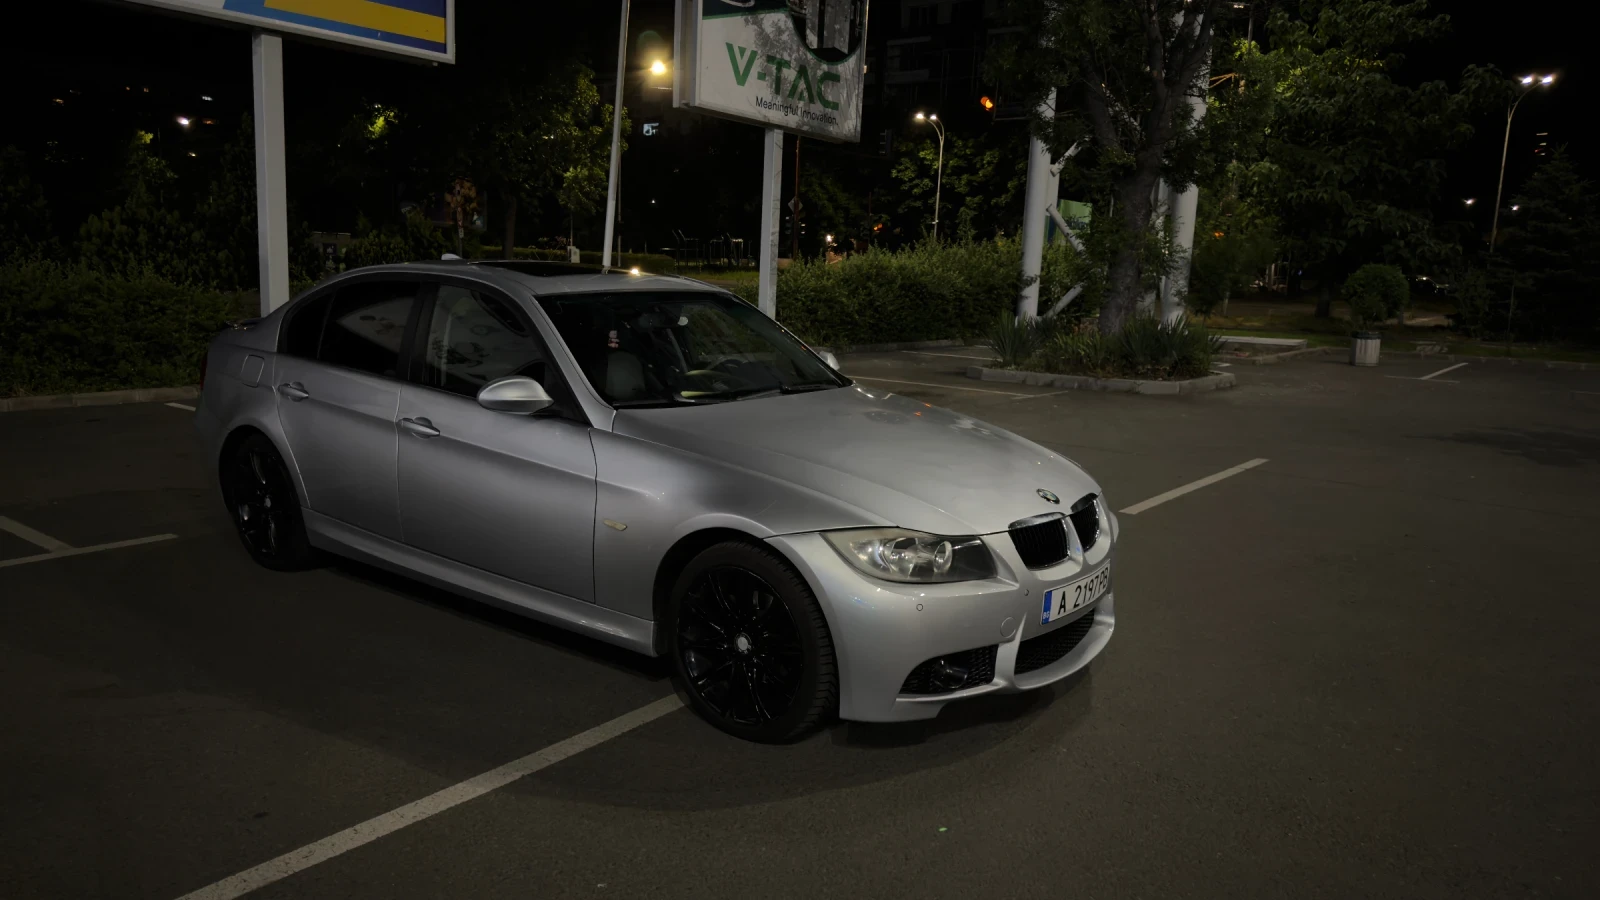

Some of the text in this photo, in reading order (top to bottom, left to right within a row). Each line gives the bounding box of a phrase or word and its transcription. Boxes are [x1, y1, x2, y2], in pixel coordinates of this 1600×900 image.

[725, 42, 840, 110] V-TAC
[755, 95, 799, 117] Meaningful
[1057, 591, 1066, 615] A
